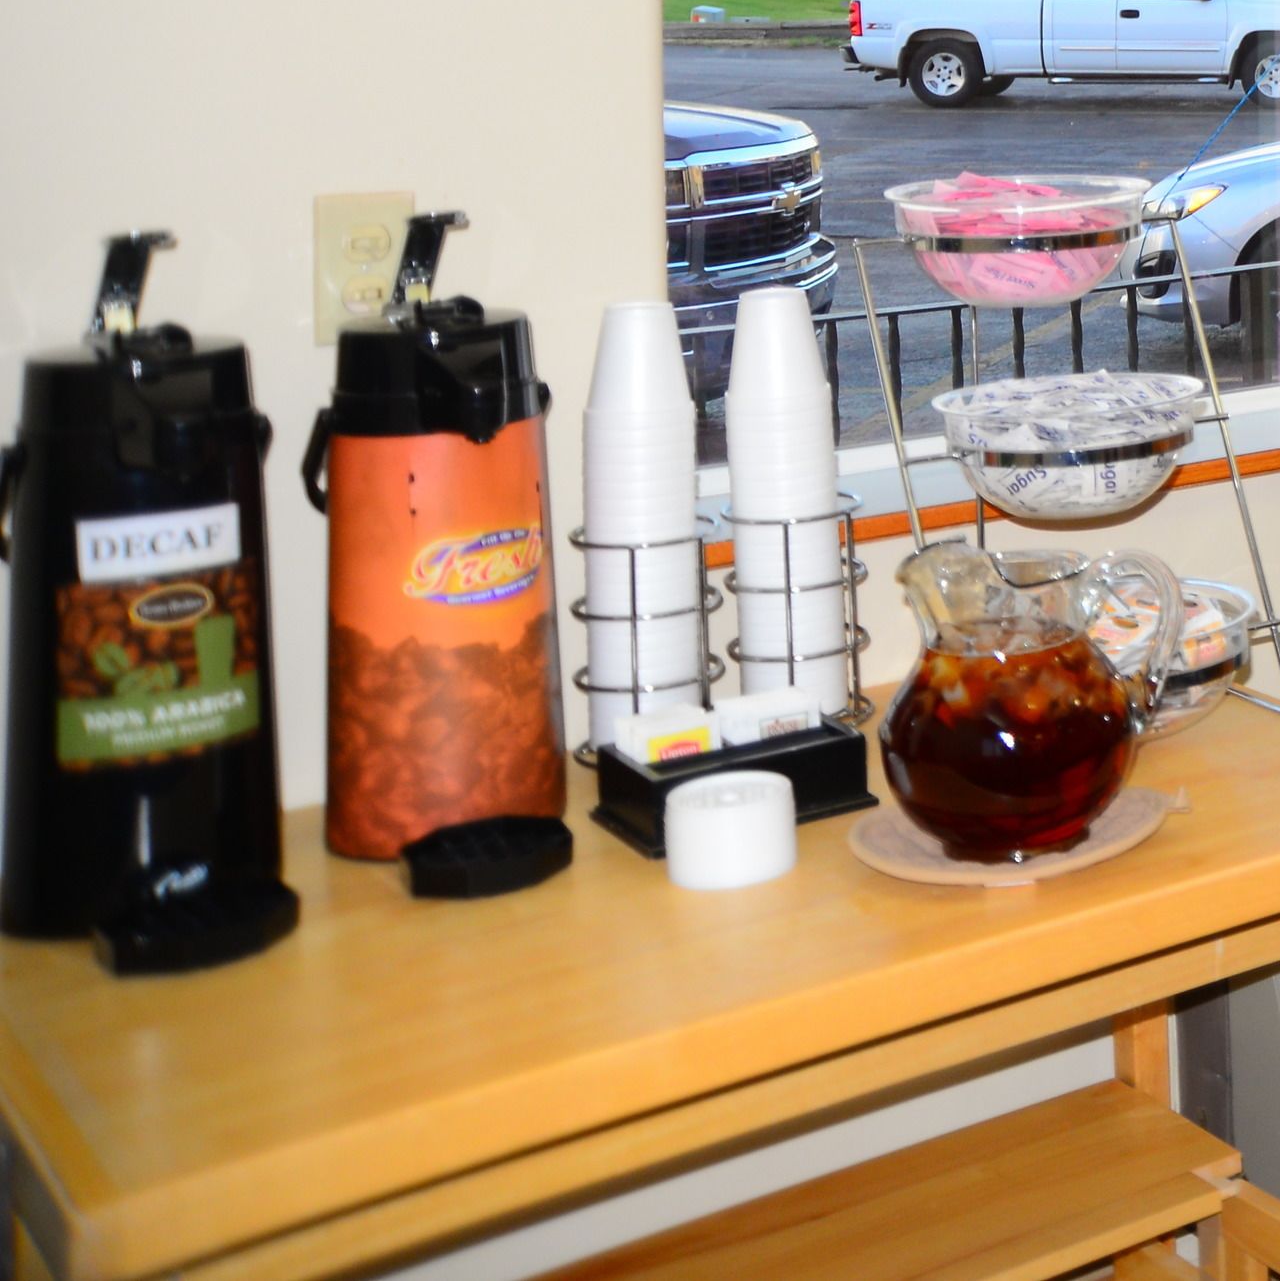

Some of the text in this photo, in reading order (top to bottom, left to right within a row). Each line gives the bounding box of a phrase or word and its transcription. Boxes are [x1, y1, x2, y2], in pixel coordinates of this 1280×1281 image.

[1006, 463, 1048, 497] Sugar
[1100, 462, 1117, 494] ugar
[90, 522, 223, 562] DECAF
[402, 523, 543, 599] Fresh
[83, 688, 246, 735] 100% ARABICA
[661, 740, 698, 761] Lipton
